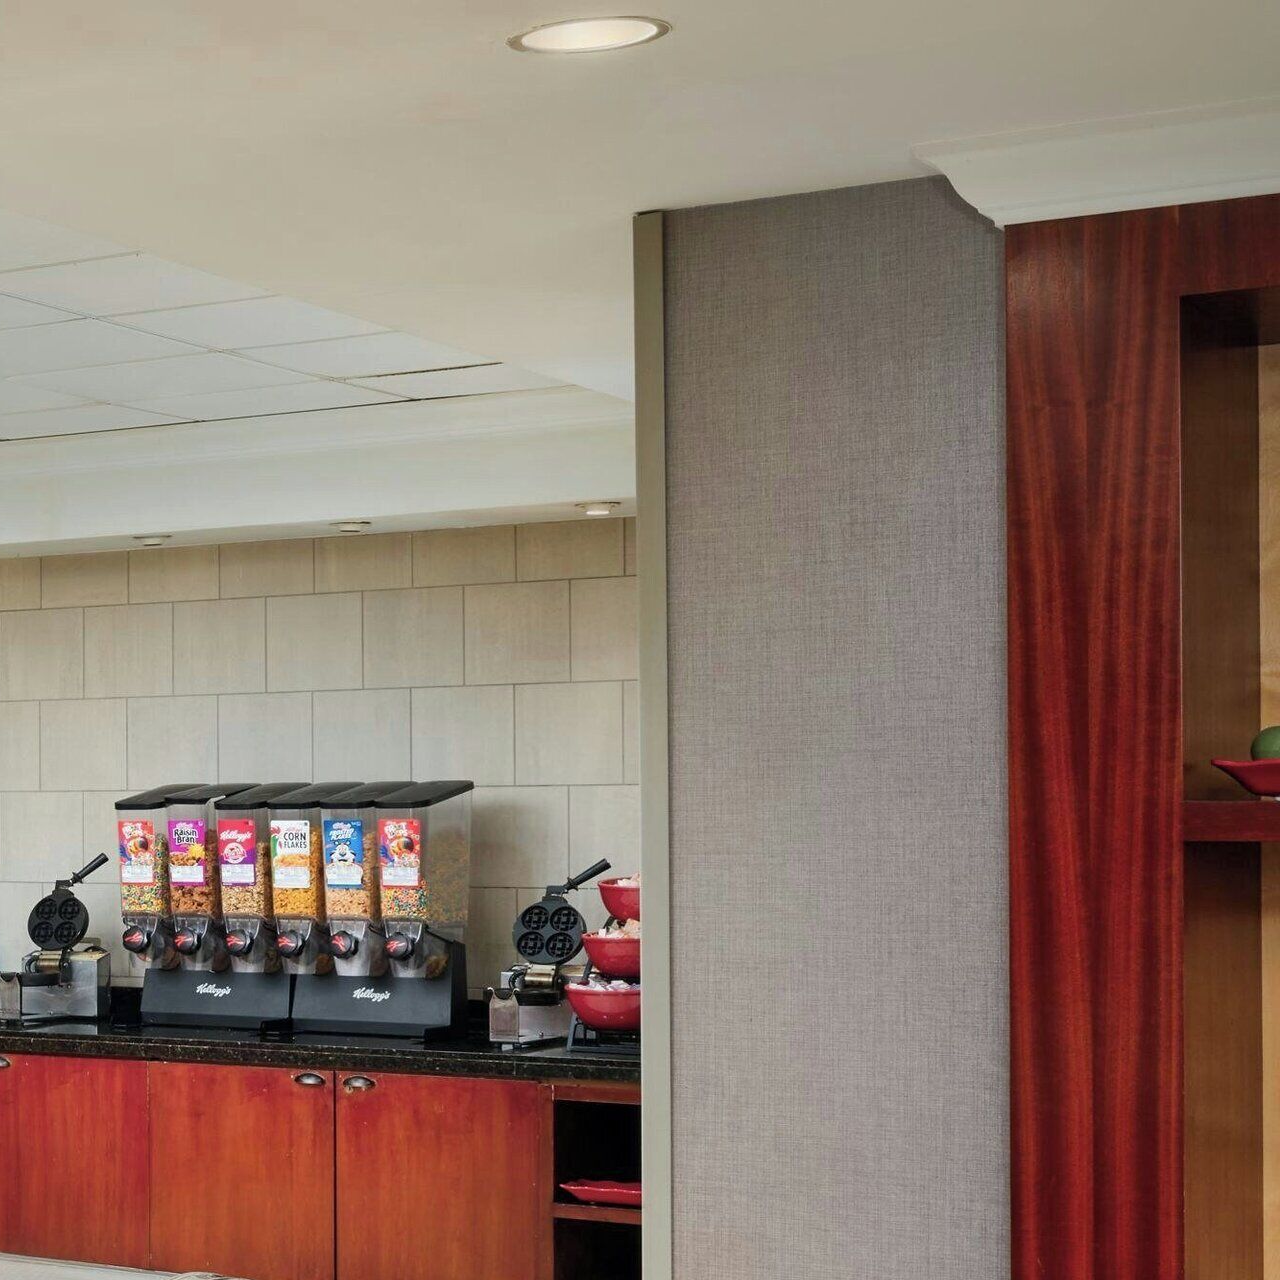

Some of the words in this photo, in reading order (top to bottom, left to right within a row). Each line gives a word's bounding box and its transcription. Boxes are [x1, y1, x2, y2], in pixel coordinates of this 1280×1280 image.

[174, 829, 197, 837] Raisin
[283, 832, 307, 841] CORN
[177, 836, 195, 844] Bran
[284, 841, 307, 849] FLAKES
[196, 983, 231, 997] Kellogg's
[352, 987, 391, 1002] Kellogg's
